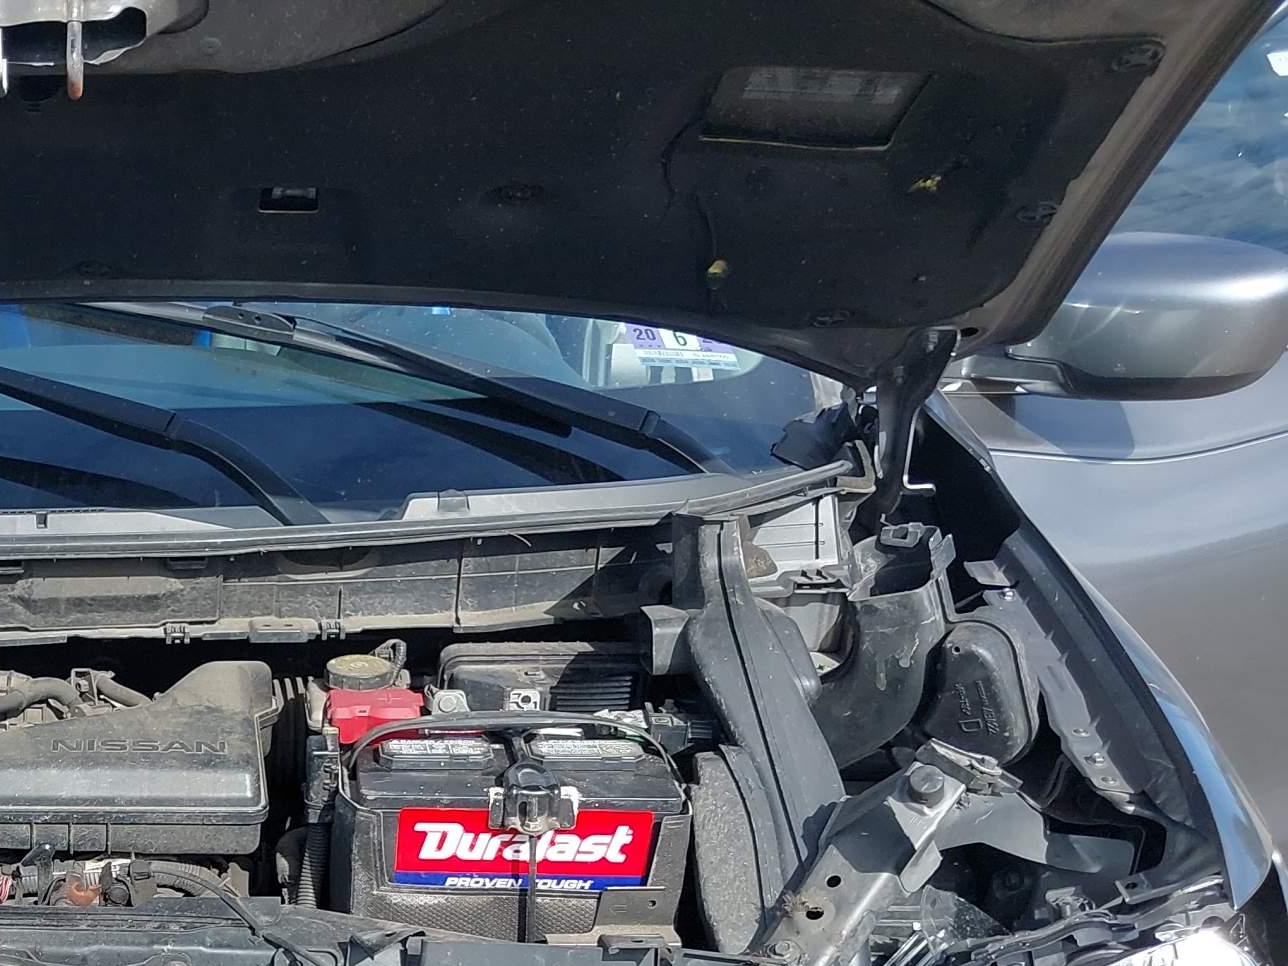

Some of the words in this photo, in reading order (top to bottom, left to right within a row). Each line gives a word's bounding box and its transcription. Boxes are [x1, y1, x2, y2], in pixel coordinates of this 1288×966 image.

[632, 327, 657, 341] 20
[672, 331, 688, 347] 6
[51, 738, 228, 755] NISSAN
[445, 877, 522, 889] PROVEN
[535, 878, 594, 889] OUGH
